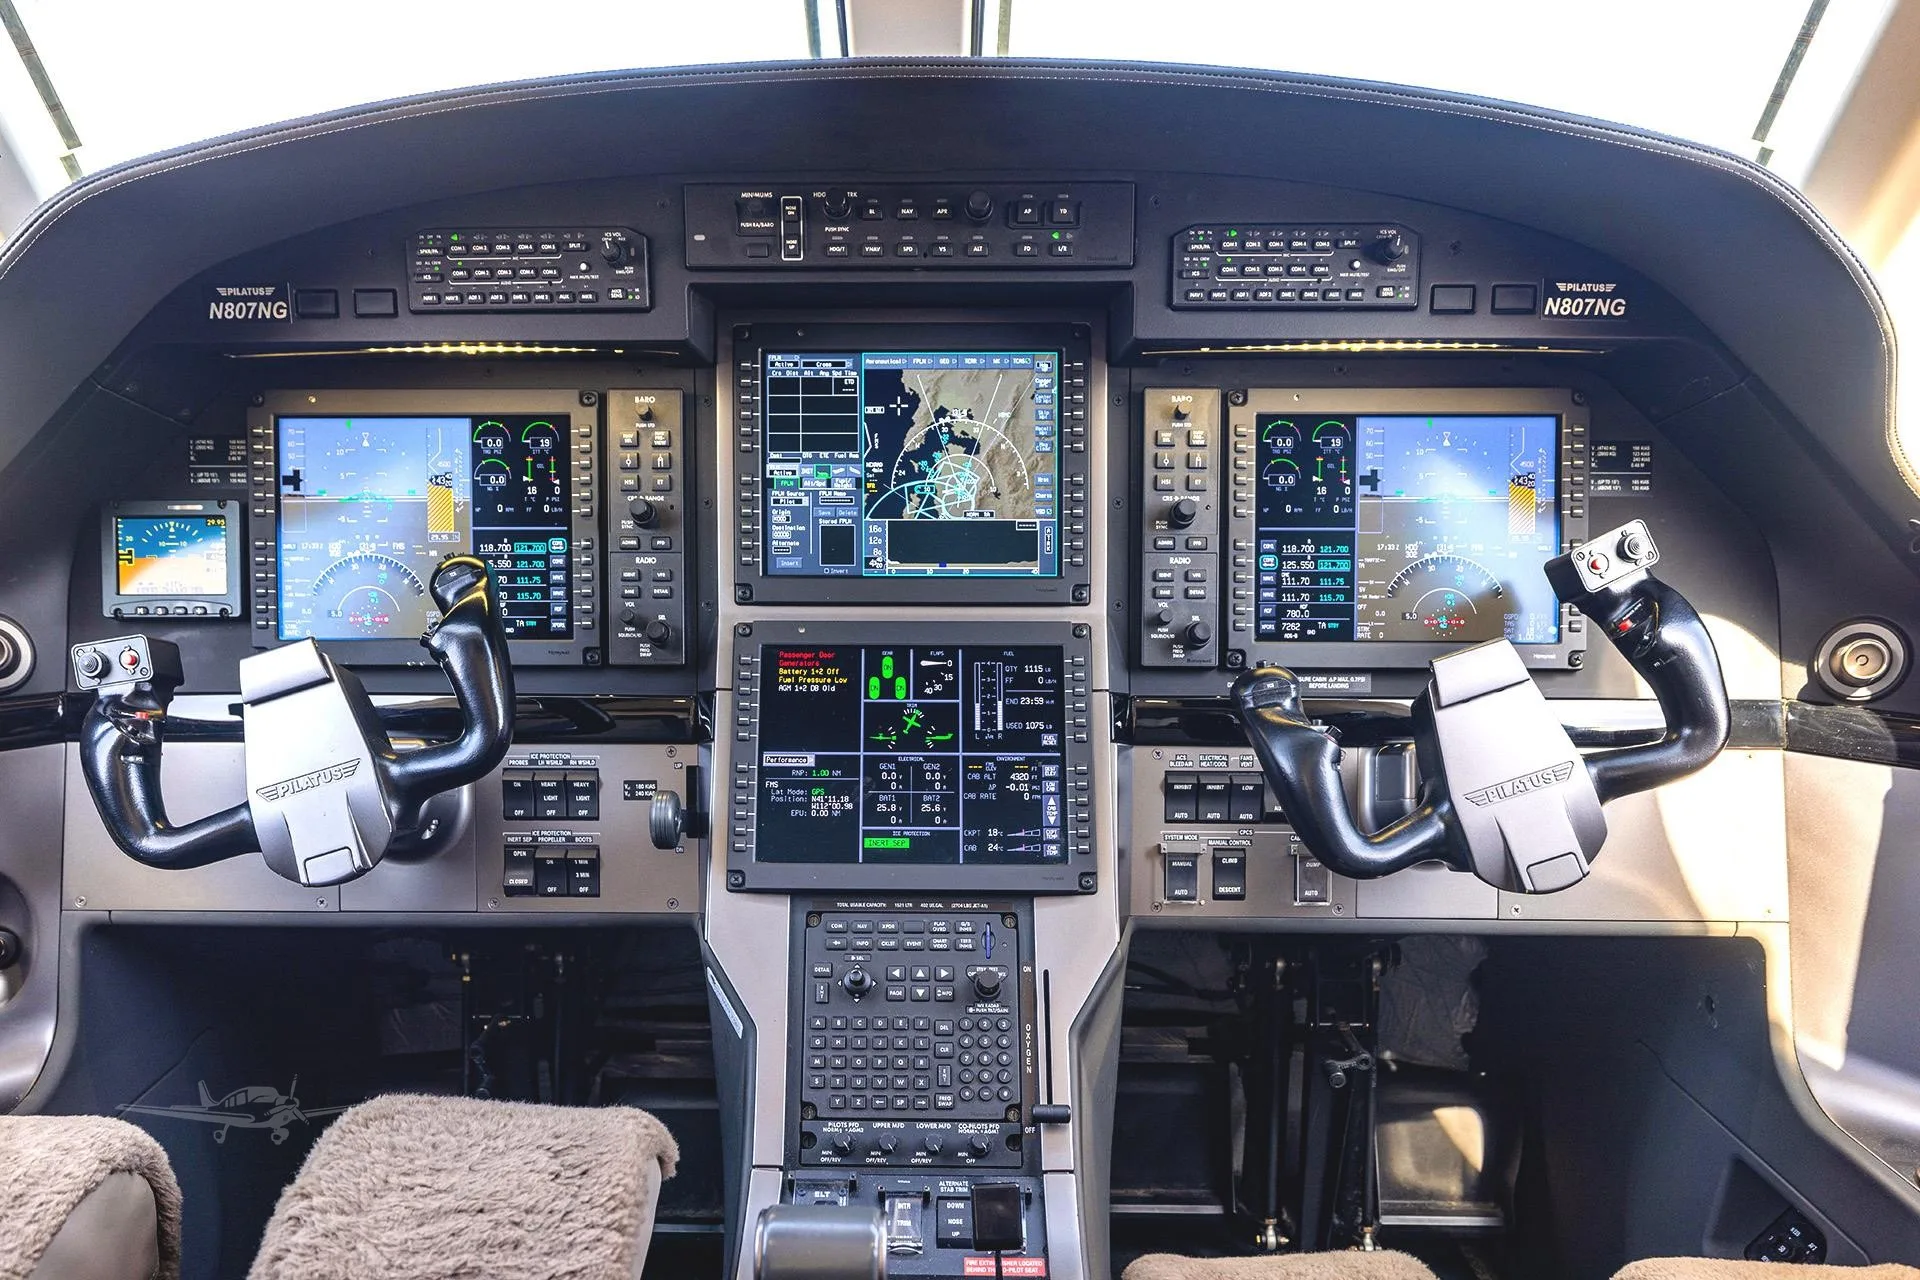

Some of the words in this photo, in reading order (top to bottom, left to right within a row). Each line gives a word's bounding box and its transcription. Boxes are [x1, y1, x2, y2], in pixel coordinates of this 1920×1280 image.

[1567, 283, 1605, 292] PILATUS
[227, 288, 265, 296] PILATUS
[209, 301, 288, 319] N807NG
[1544, 297, 1627, 316] N807NG
[1277, 439, 1292, 447] 0.0
[1279, 476, 1294, 484] 0.0
[1282, 593, 1310, 601] 111.70
[1286, 610, 1310, 618] 780.0
[779, 651, 815, 659] Passenger
[779, 668, 808, 676] Battery
[1020, 697, 1044, 705] 23:59
[1010, 772, 1030, 780] 4320
[281, 767, 343, 798] PILATUS
[1485, 771, 1553, 803] PILATUS
[876, 804, 896, 812] 25.8
[921, 804, 940, 812] 25.6
